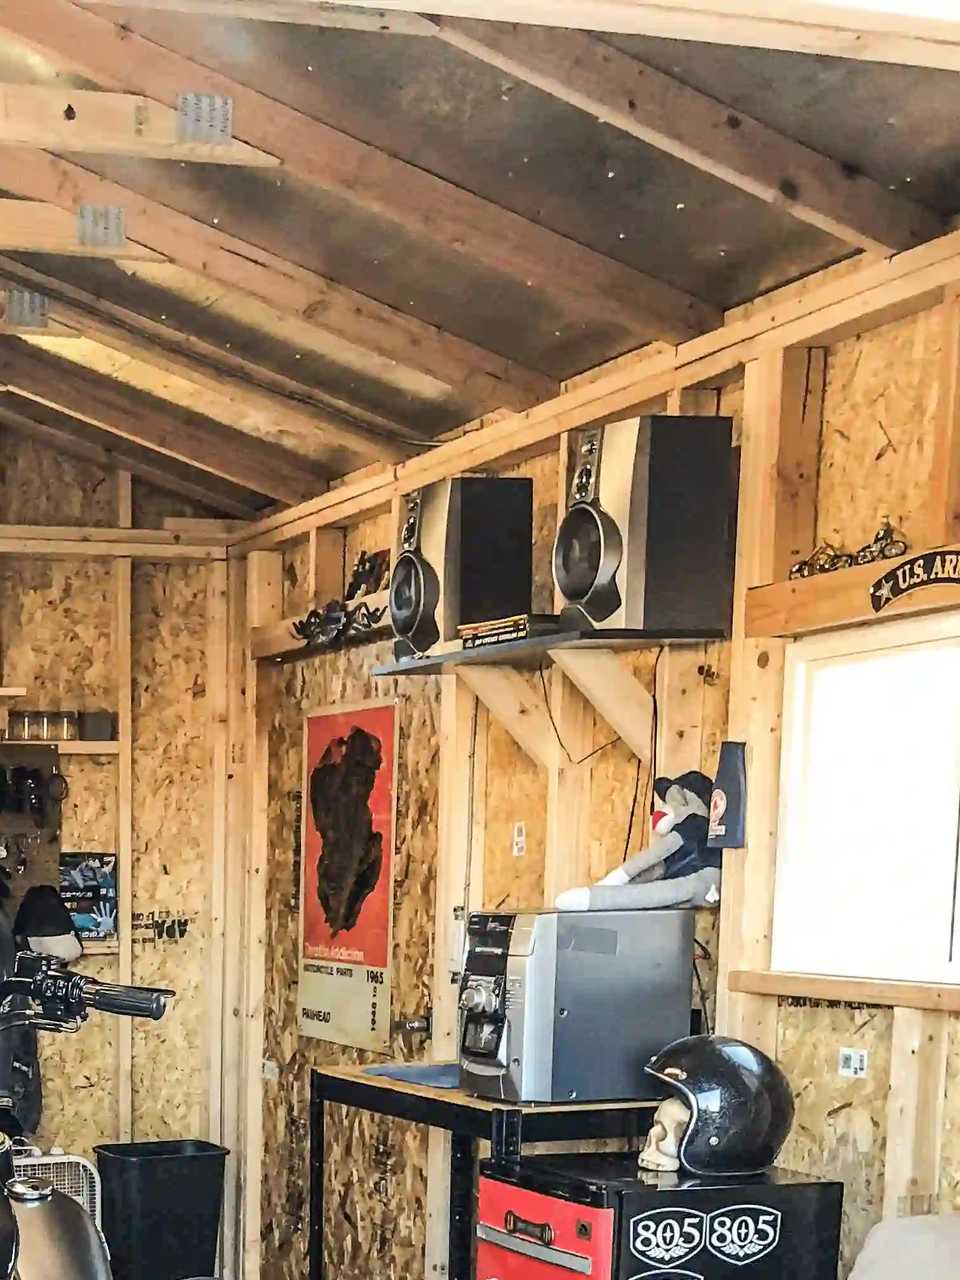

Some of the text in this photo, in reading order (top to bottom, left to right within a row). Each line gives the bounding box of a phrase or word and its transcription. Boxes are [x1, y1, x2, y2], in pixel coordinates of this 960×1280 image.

[896, 554, 960, 589] U.S. AR
[366, 970, 384, 984] 1965
[635, 1217, 701, 1250] 805
[711, 1215, 775, 1247] 805
